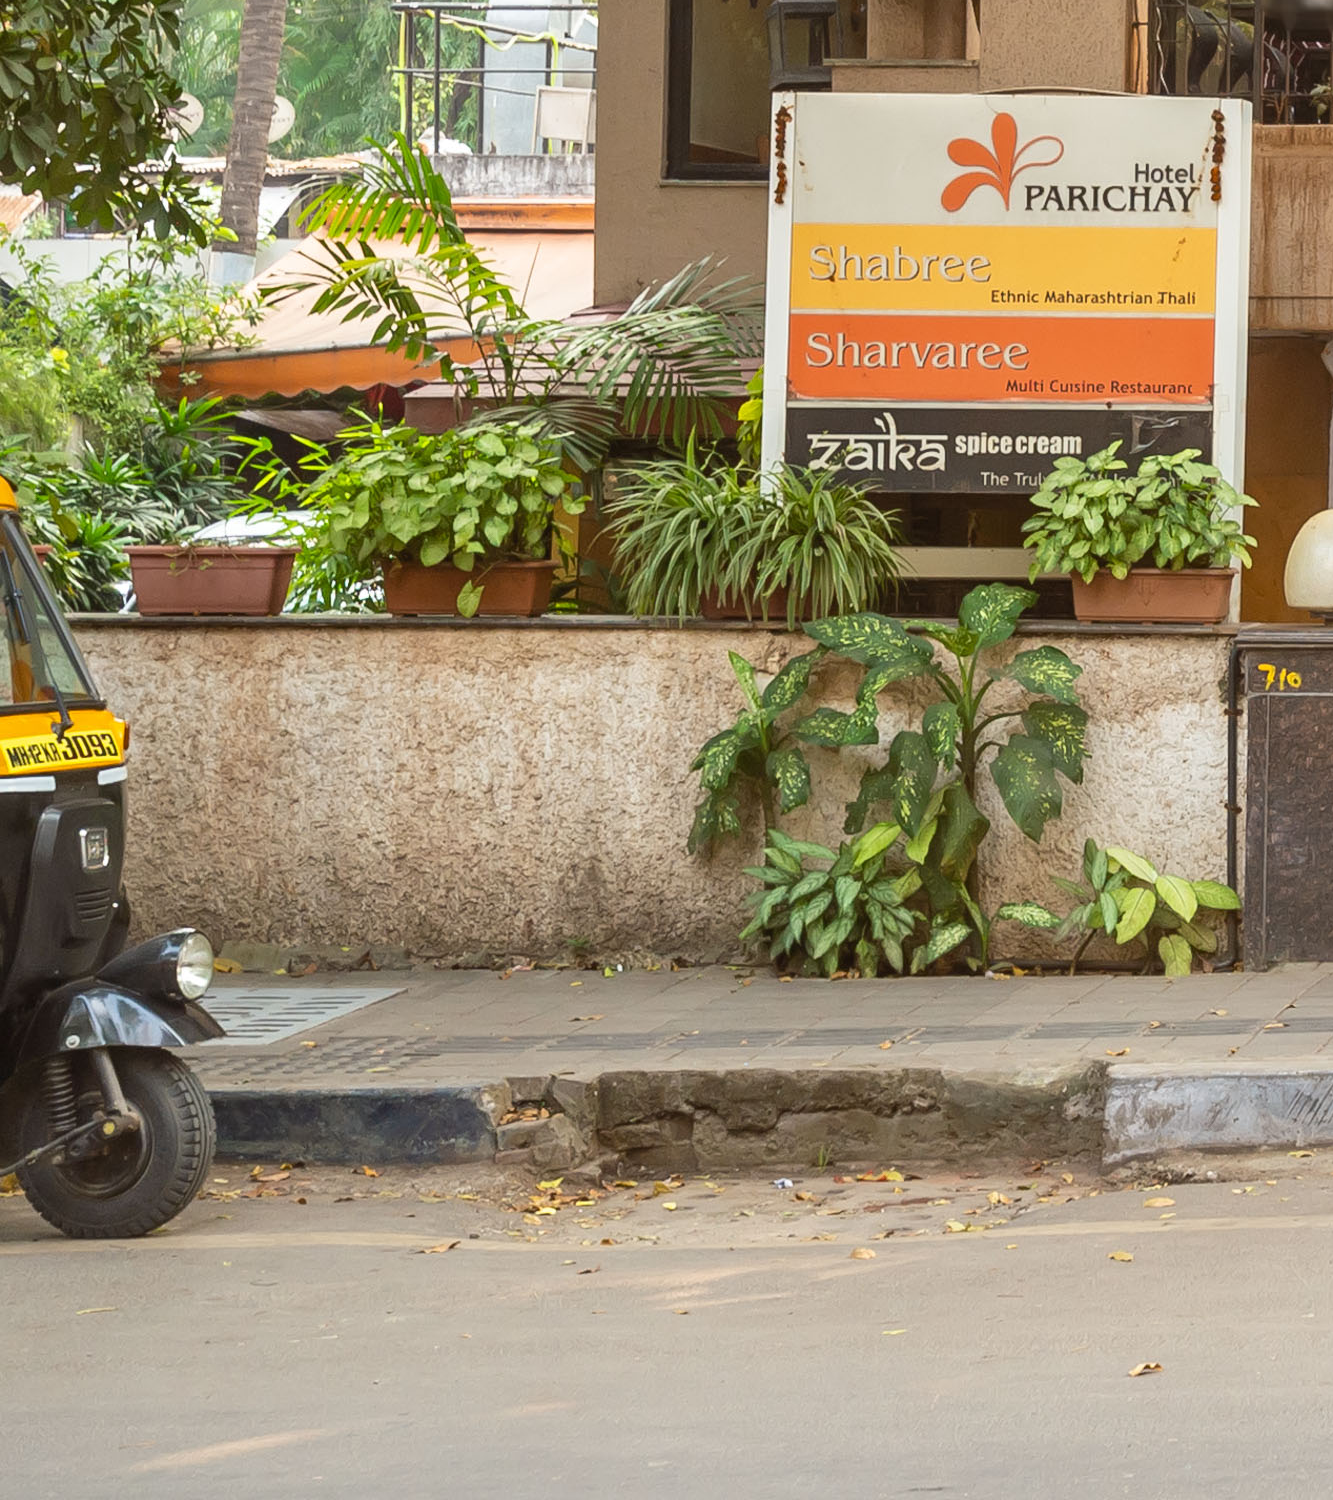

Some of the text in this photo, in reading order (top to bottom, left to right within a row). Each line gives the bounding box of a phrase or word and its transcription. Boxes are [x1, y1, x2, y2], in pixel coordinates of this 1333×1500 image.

[1134, 163, 1196, 184] Hotel
[1024, 185, 1200, 213] PARICHAY
[809, 245, 992, 282] Shabree
[991, 289, 1196, 305] Ethnic Maharashtrian Thali
[805, 332, 1029, 370] Sharvaree
[1005, 379, 1044, 393] Multi
[1049, 379, 1105, 394] Cuisine
[807, 412, 1082, 471] zaika spice cream
[980, 471, 1009, 487] The
[1258, 664, 1302, 690] 710
